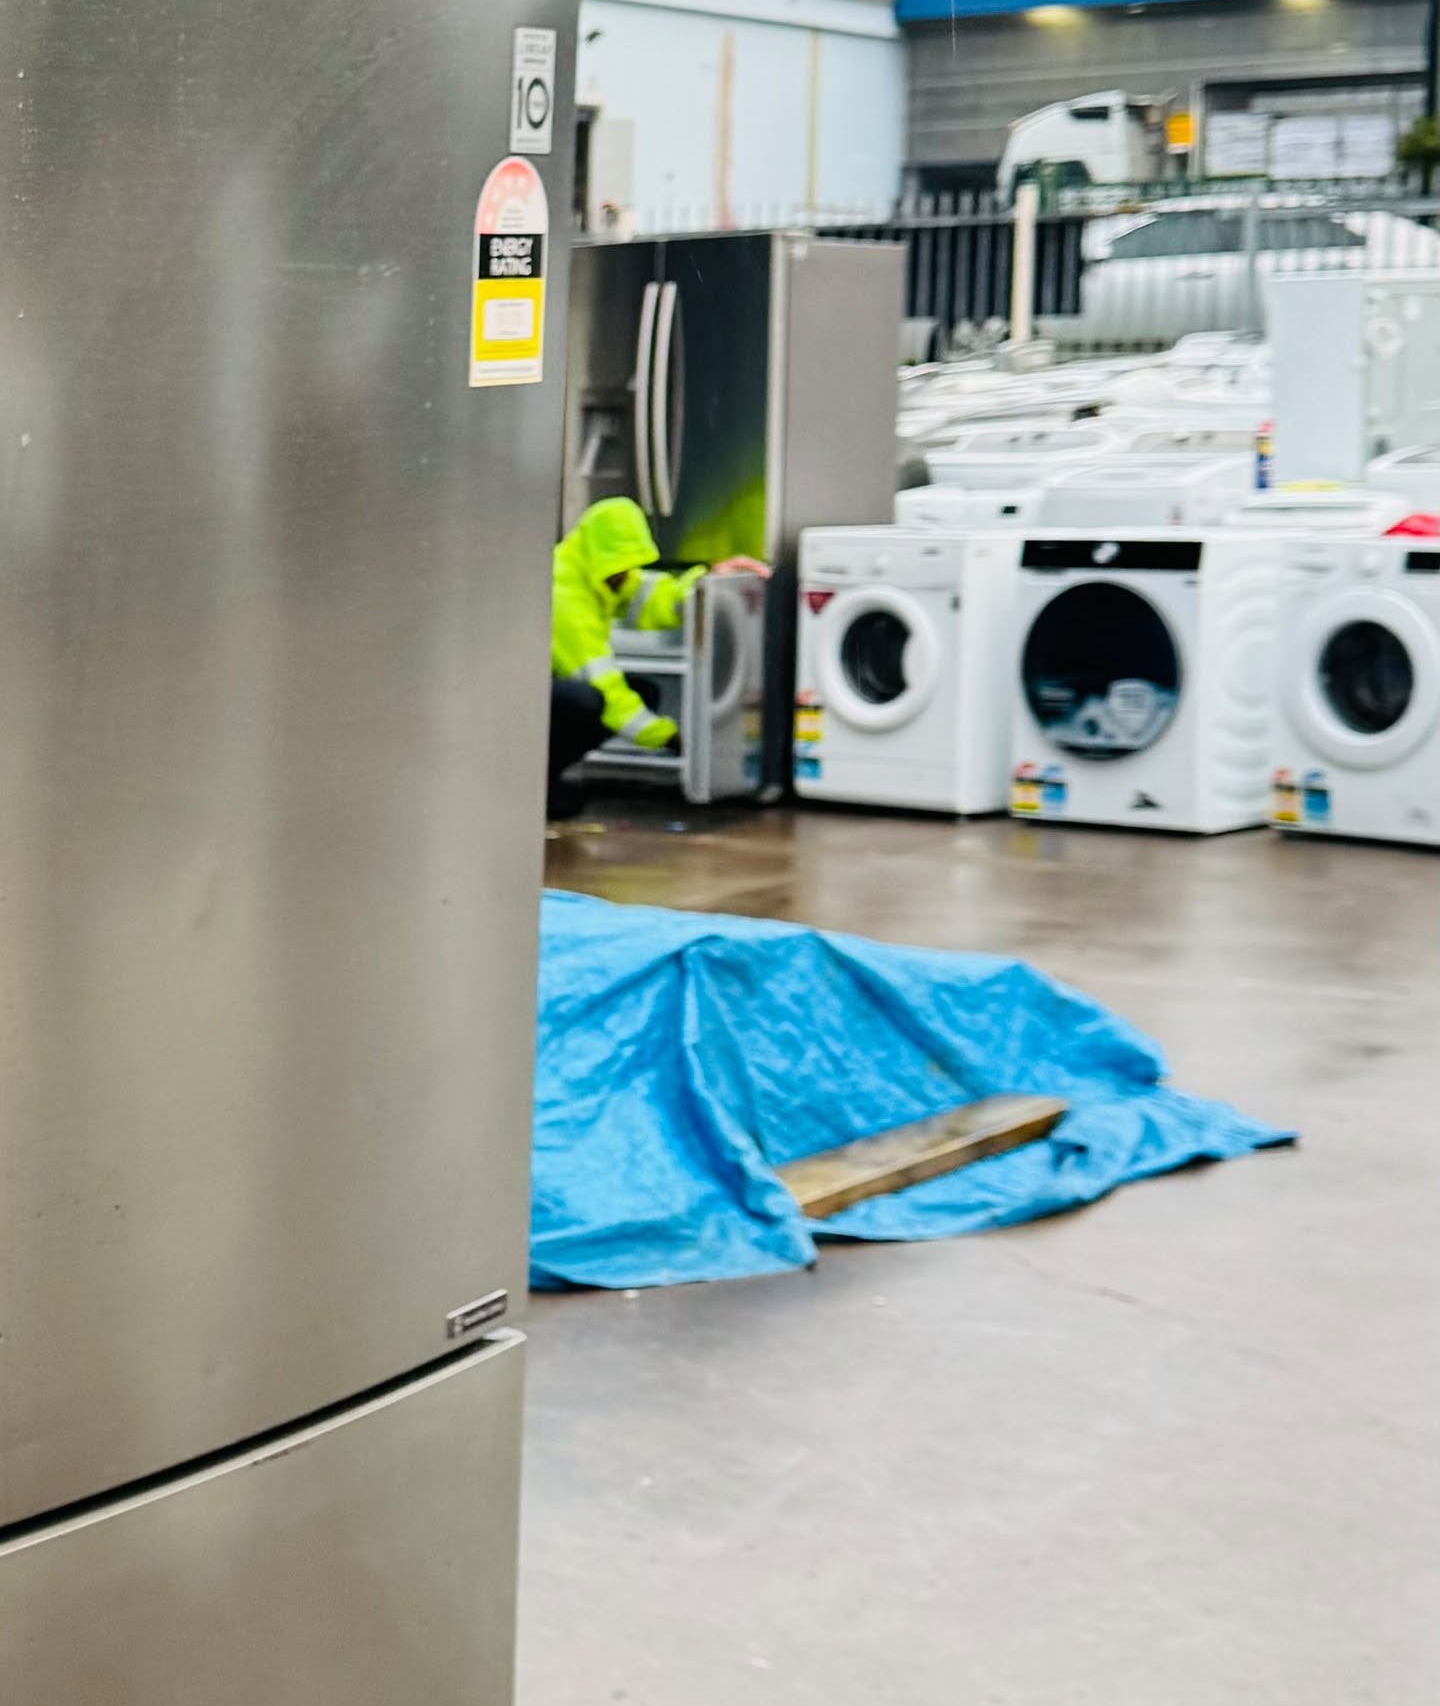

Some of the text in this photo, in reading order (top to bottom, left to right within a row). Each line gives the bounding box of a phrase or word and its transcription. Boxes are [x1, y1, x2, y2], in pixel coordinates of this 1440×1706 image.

[517, 76, 550, 129] 10
[489, 237, 533, 257] ENERGY
[489, 257, 533, 276] RATING
